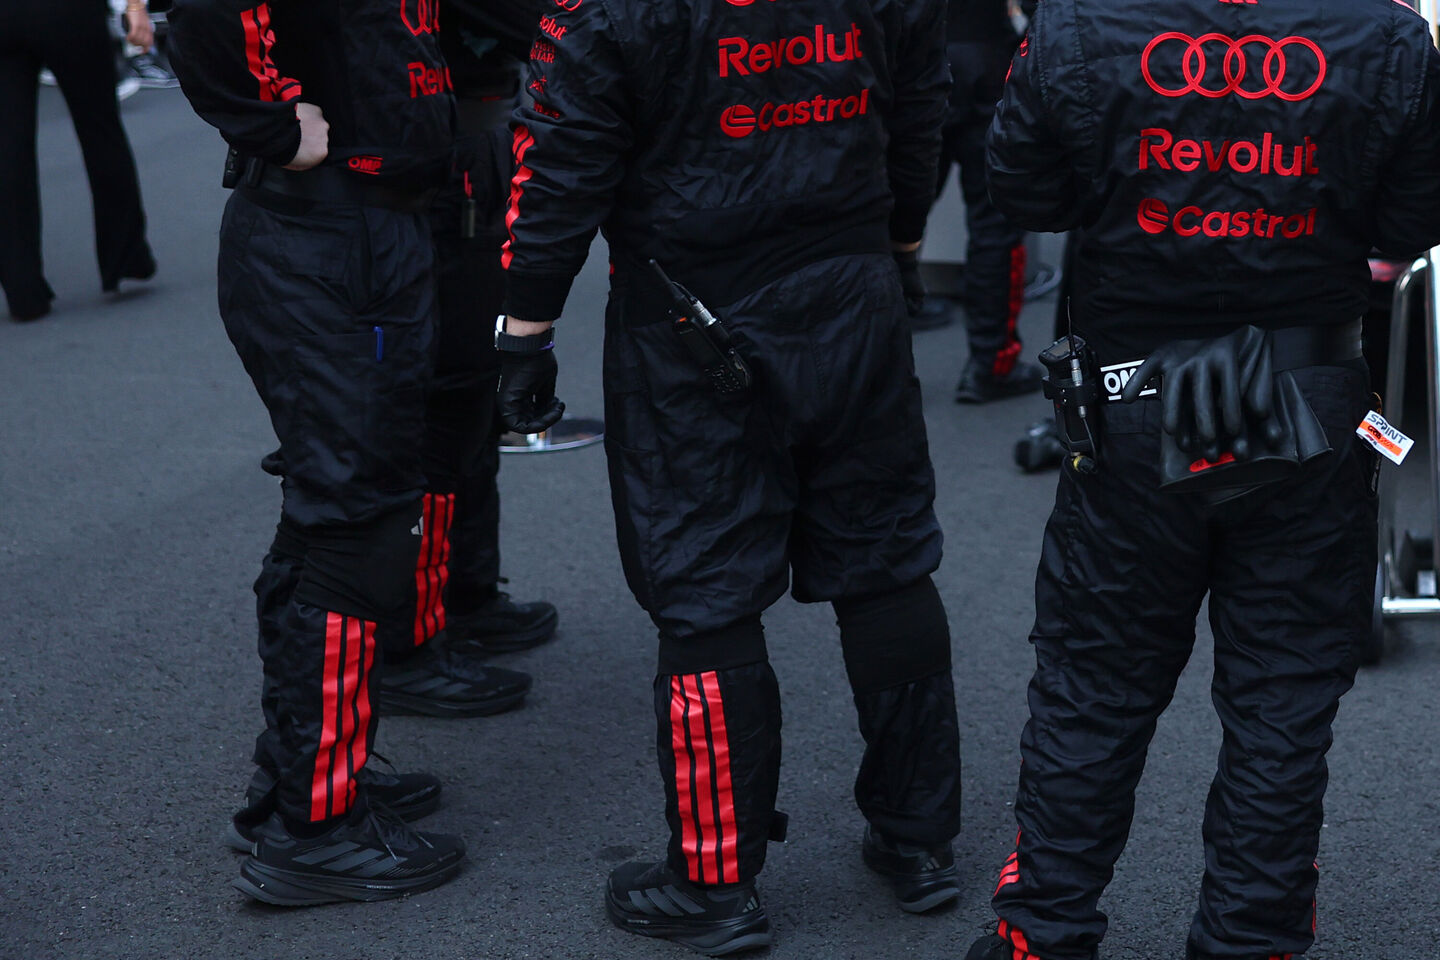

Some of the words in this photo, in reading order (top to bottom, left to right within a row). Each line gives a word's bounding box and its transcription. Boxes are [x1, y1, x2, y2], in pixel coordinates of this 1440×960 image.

[718, 23, 862, 77] Revolut
[758, 89, 868, 132] Castrol
[348, 156, 383, 172] OMP
[1138, 128, 1319, 176] Revolut
[1172, 205, 1317, 239] Castrol
[1367, 413, 1408, 444] SPRINT
